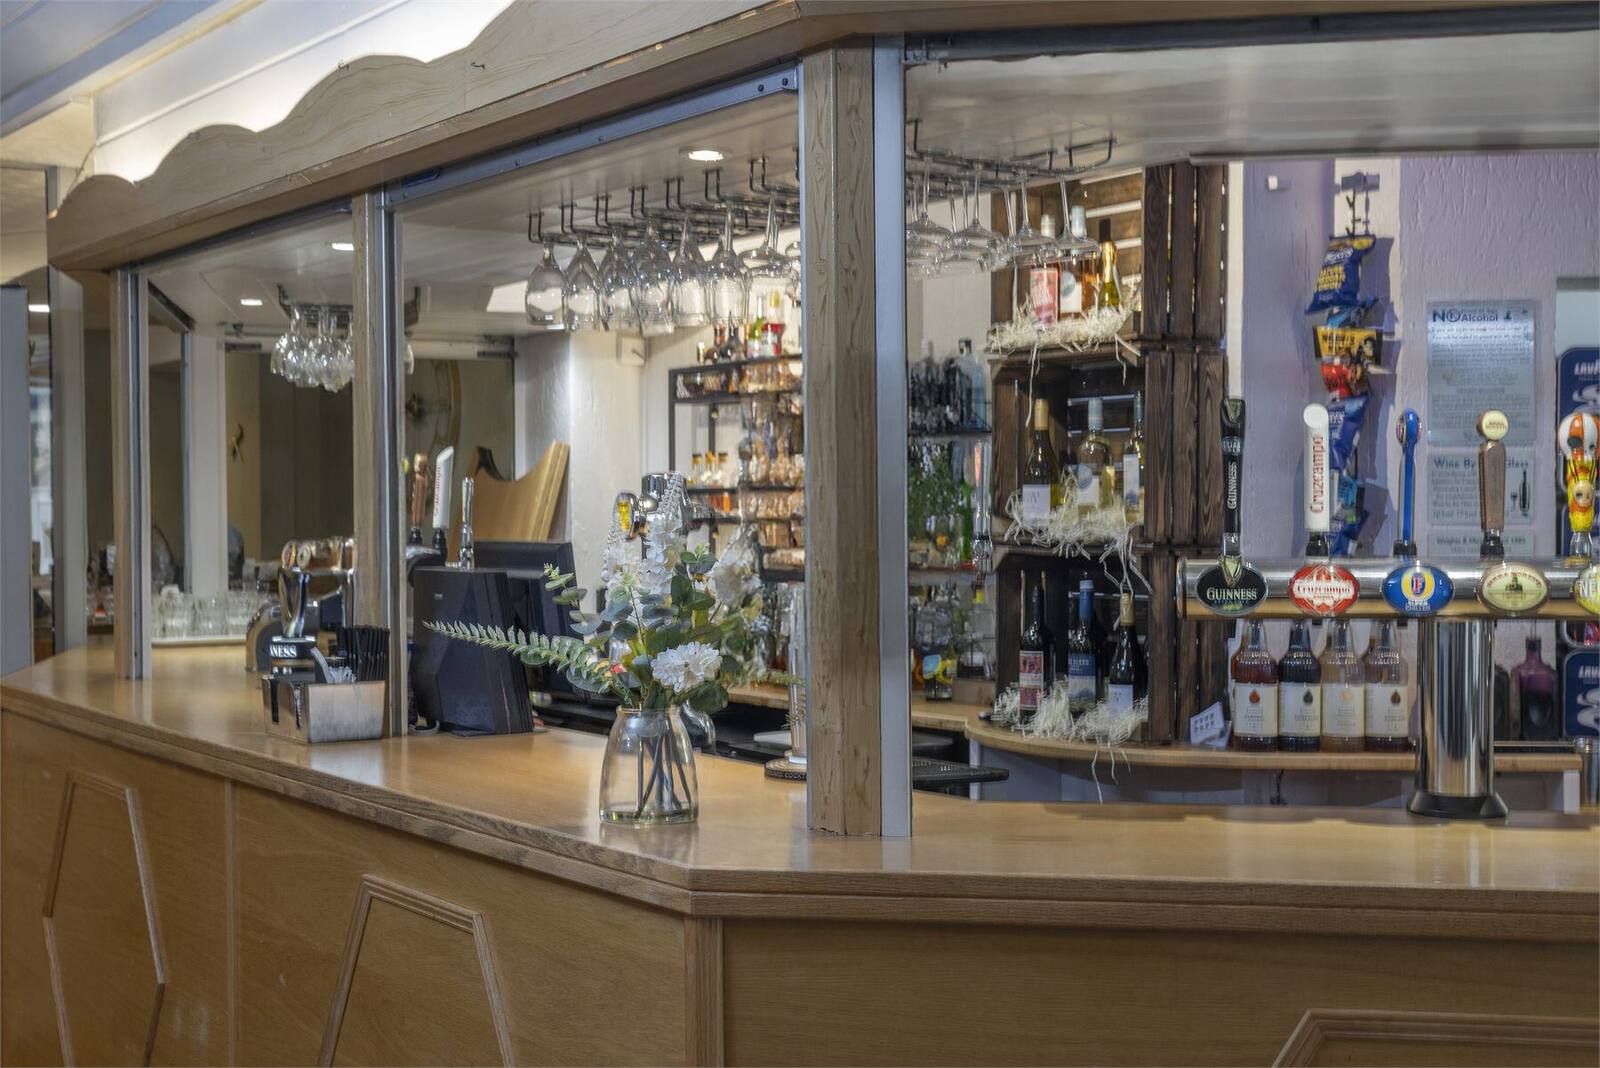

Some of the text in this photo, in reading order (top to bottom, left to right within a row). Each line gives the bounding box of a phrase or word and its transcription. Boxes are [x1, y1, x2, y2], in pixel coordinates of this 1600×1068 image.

[1461, 313, 1499, 322] Alcohol
[1434, 457, 1461, 468] Wine
[1310, 433, 1325, 513] Cruzcampo
[1227, 461, 1237, 509] GUINNESS
[1206, 587, 1257, 601] GUINNESS
[1578, 665, 1600, 679] LAV
